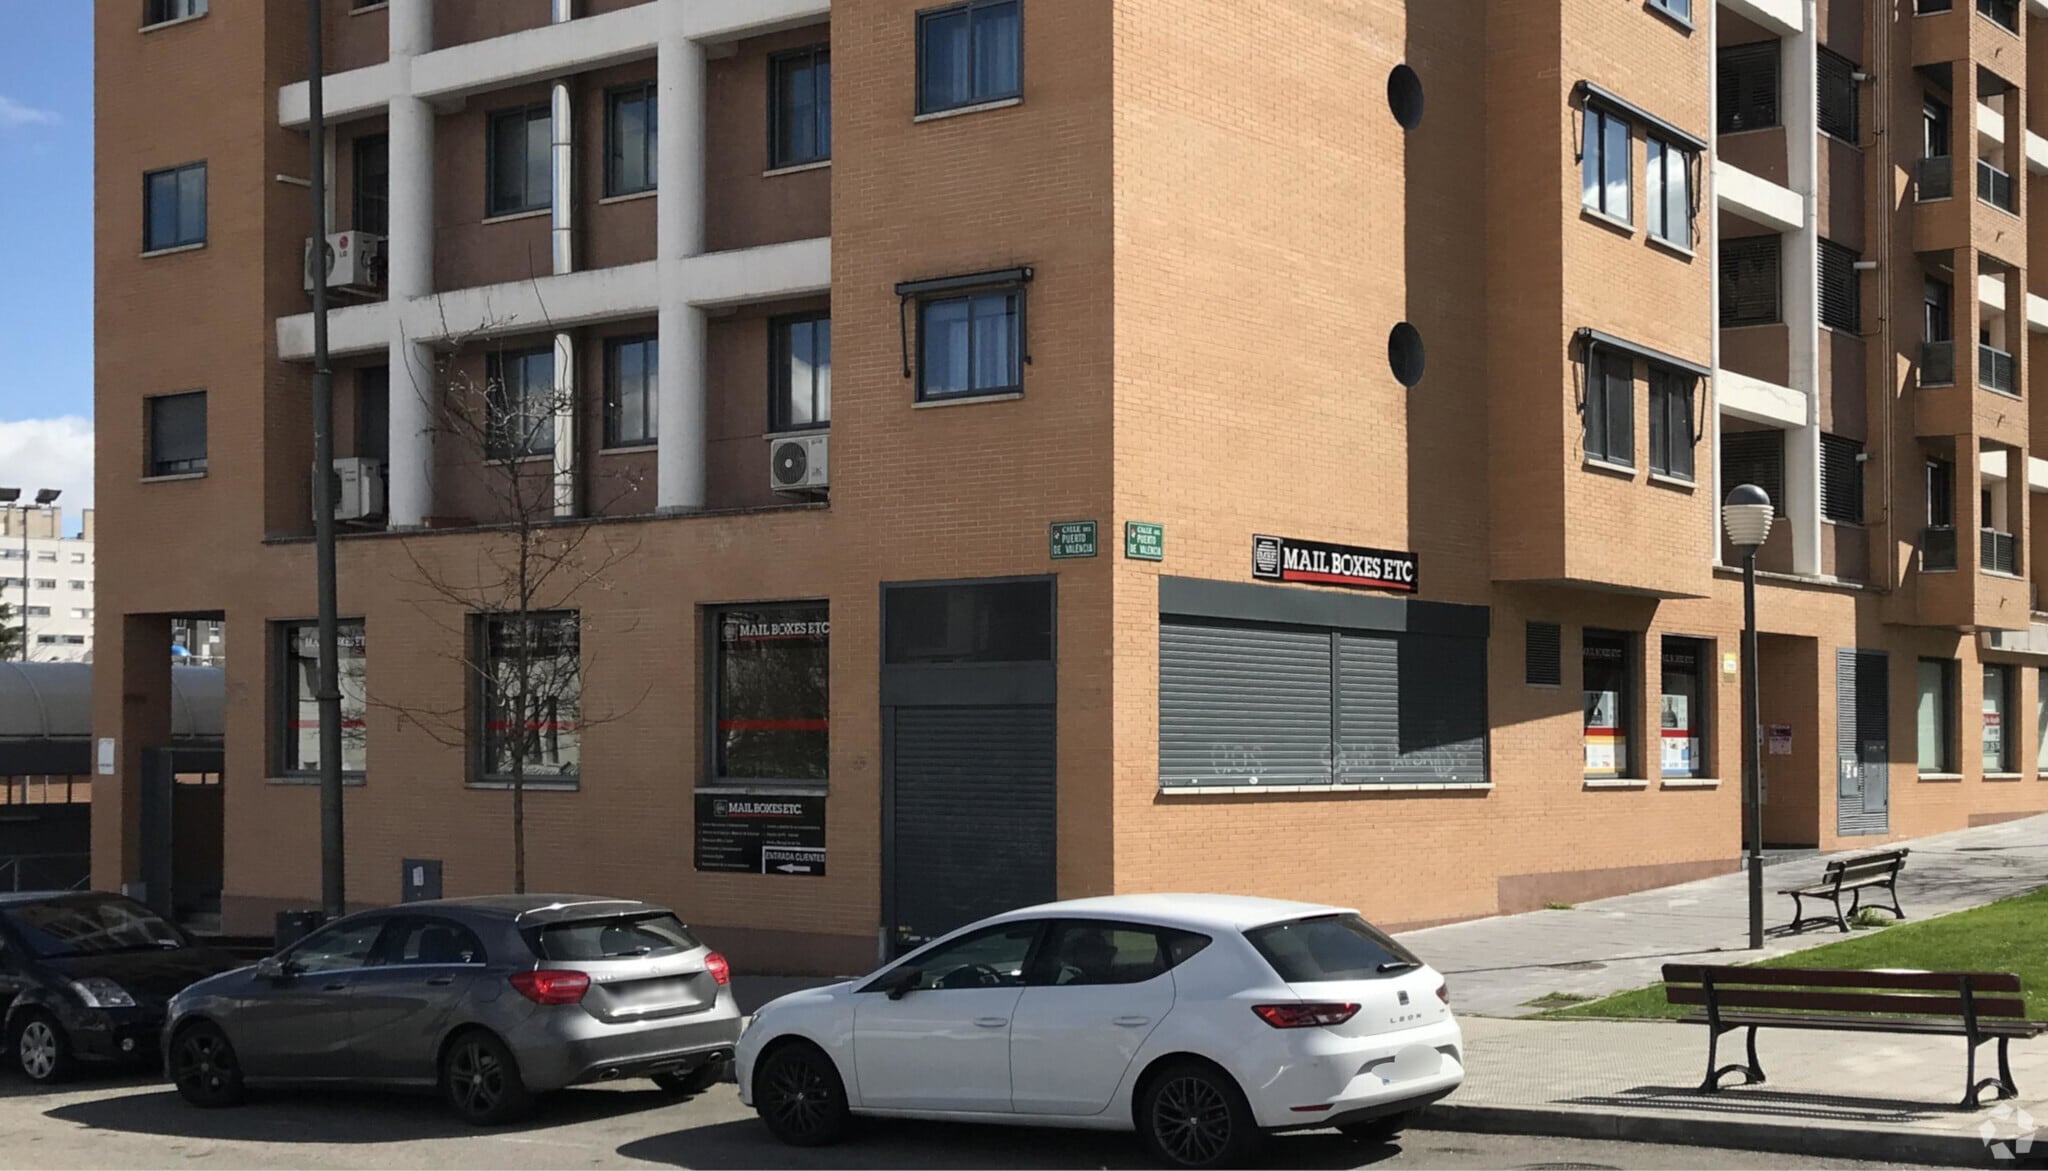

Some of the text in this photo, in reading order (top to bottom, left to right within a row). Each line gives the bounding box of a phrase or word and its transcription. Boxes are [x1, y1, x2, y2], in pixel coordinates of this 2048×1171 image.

[1137, 526, 1153, 534] CALLE
[1062, 534, 1086, 543] PUERTO
[1137, 535, 1157, 544] PUERTO
[1053, 543, 1093, 554] DE VALENCIA
[1130, 544, 1162, 556] DE VALENCIA
[1283, 547, 1413, 582] MAIL BOXES ETC
[739, 624, 770, 636] MAIL
[771, 622, 807, 636] BOXES
[808, 621, 830, 635] ETC
[728, 802, 753, 813] MAIL
[753, 803, 783, 814] BOXES
[766, 851, 824, 863] ENTRADA CLIENTES
[1390, 1014, 1422, 1024] LEON
